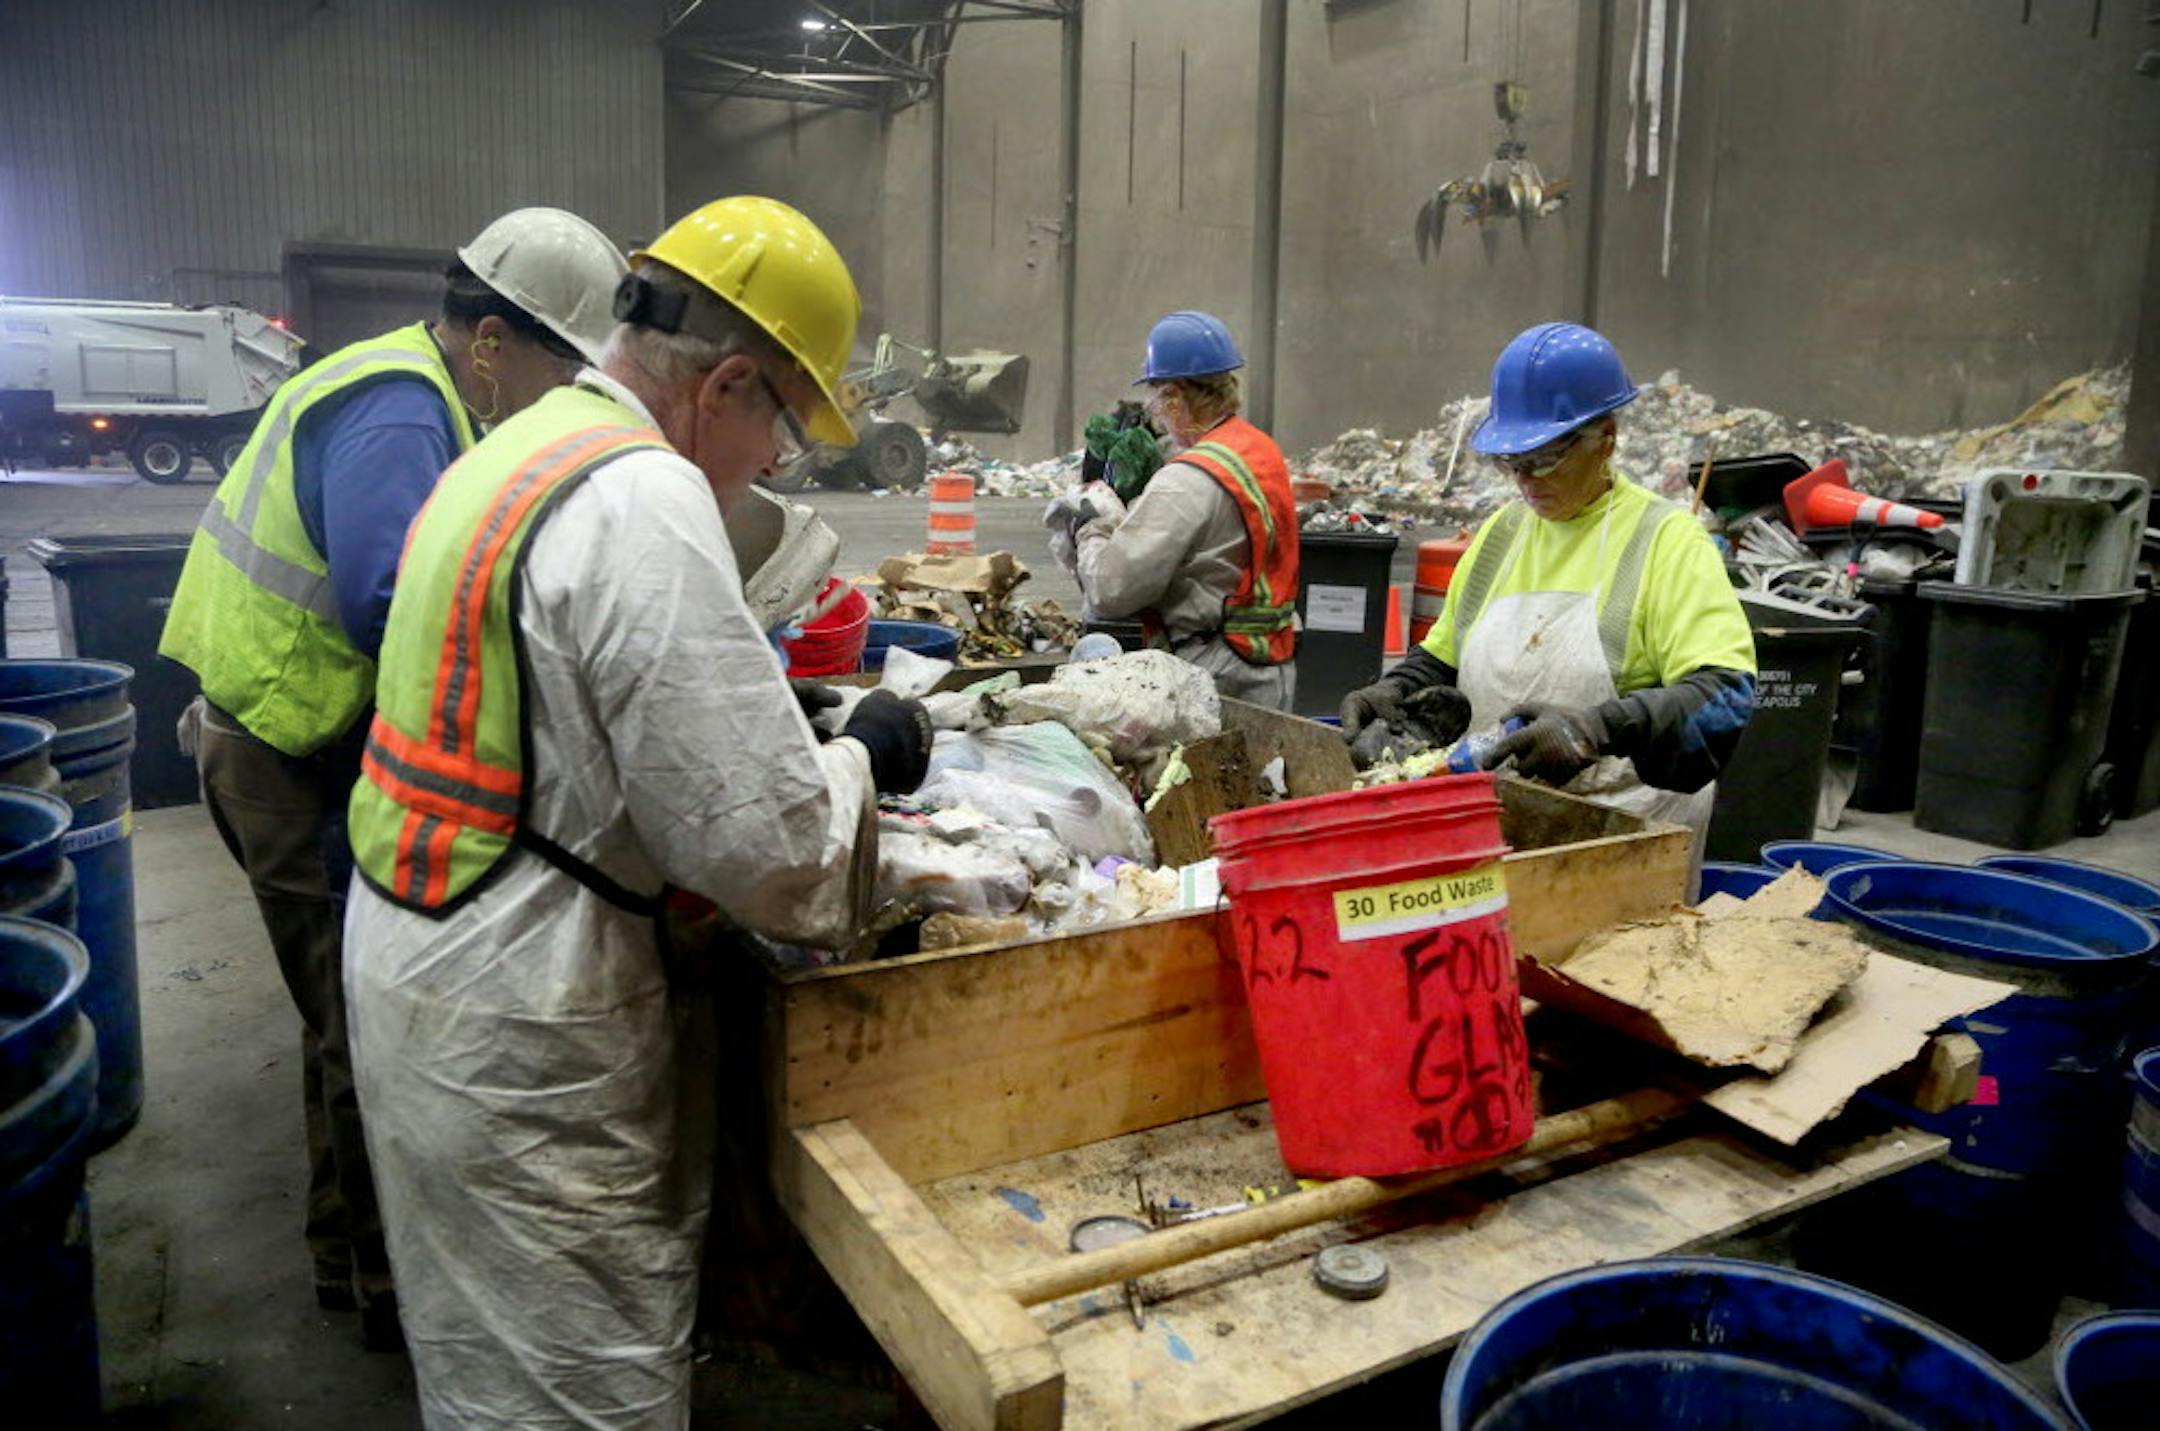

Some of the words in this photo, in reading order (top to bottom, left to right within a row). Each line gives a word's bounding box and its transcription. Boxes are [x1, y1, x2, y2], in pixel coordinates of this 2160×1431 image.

[1773, 683, 1793, 696] THE
[1795, 683, 1818, 695] CITY
[1346, 897, 1375, 918] 30
[1389, 884, 1442, 912] Food
[1447, 876, 1494, 900] Waste
